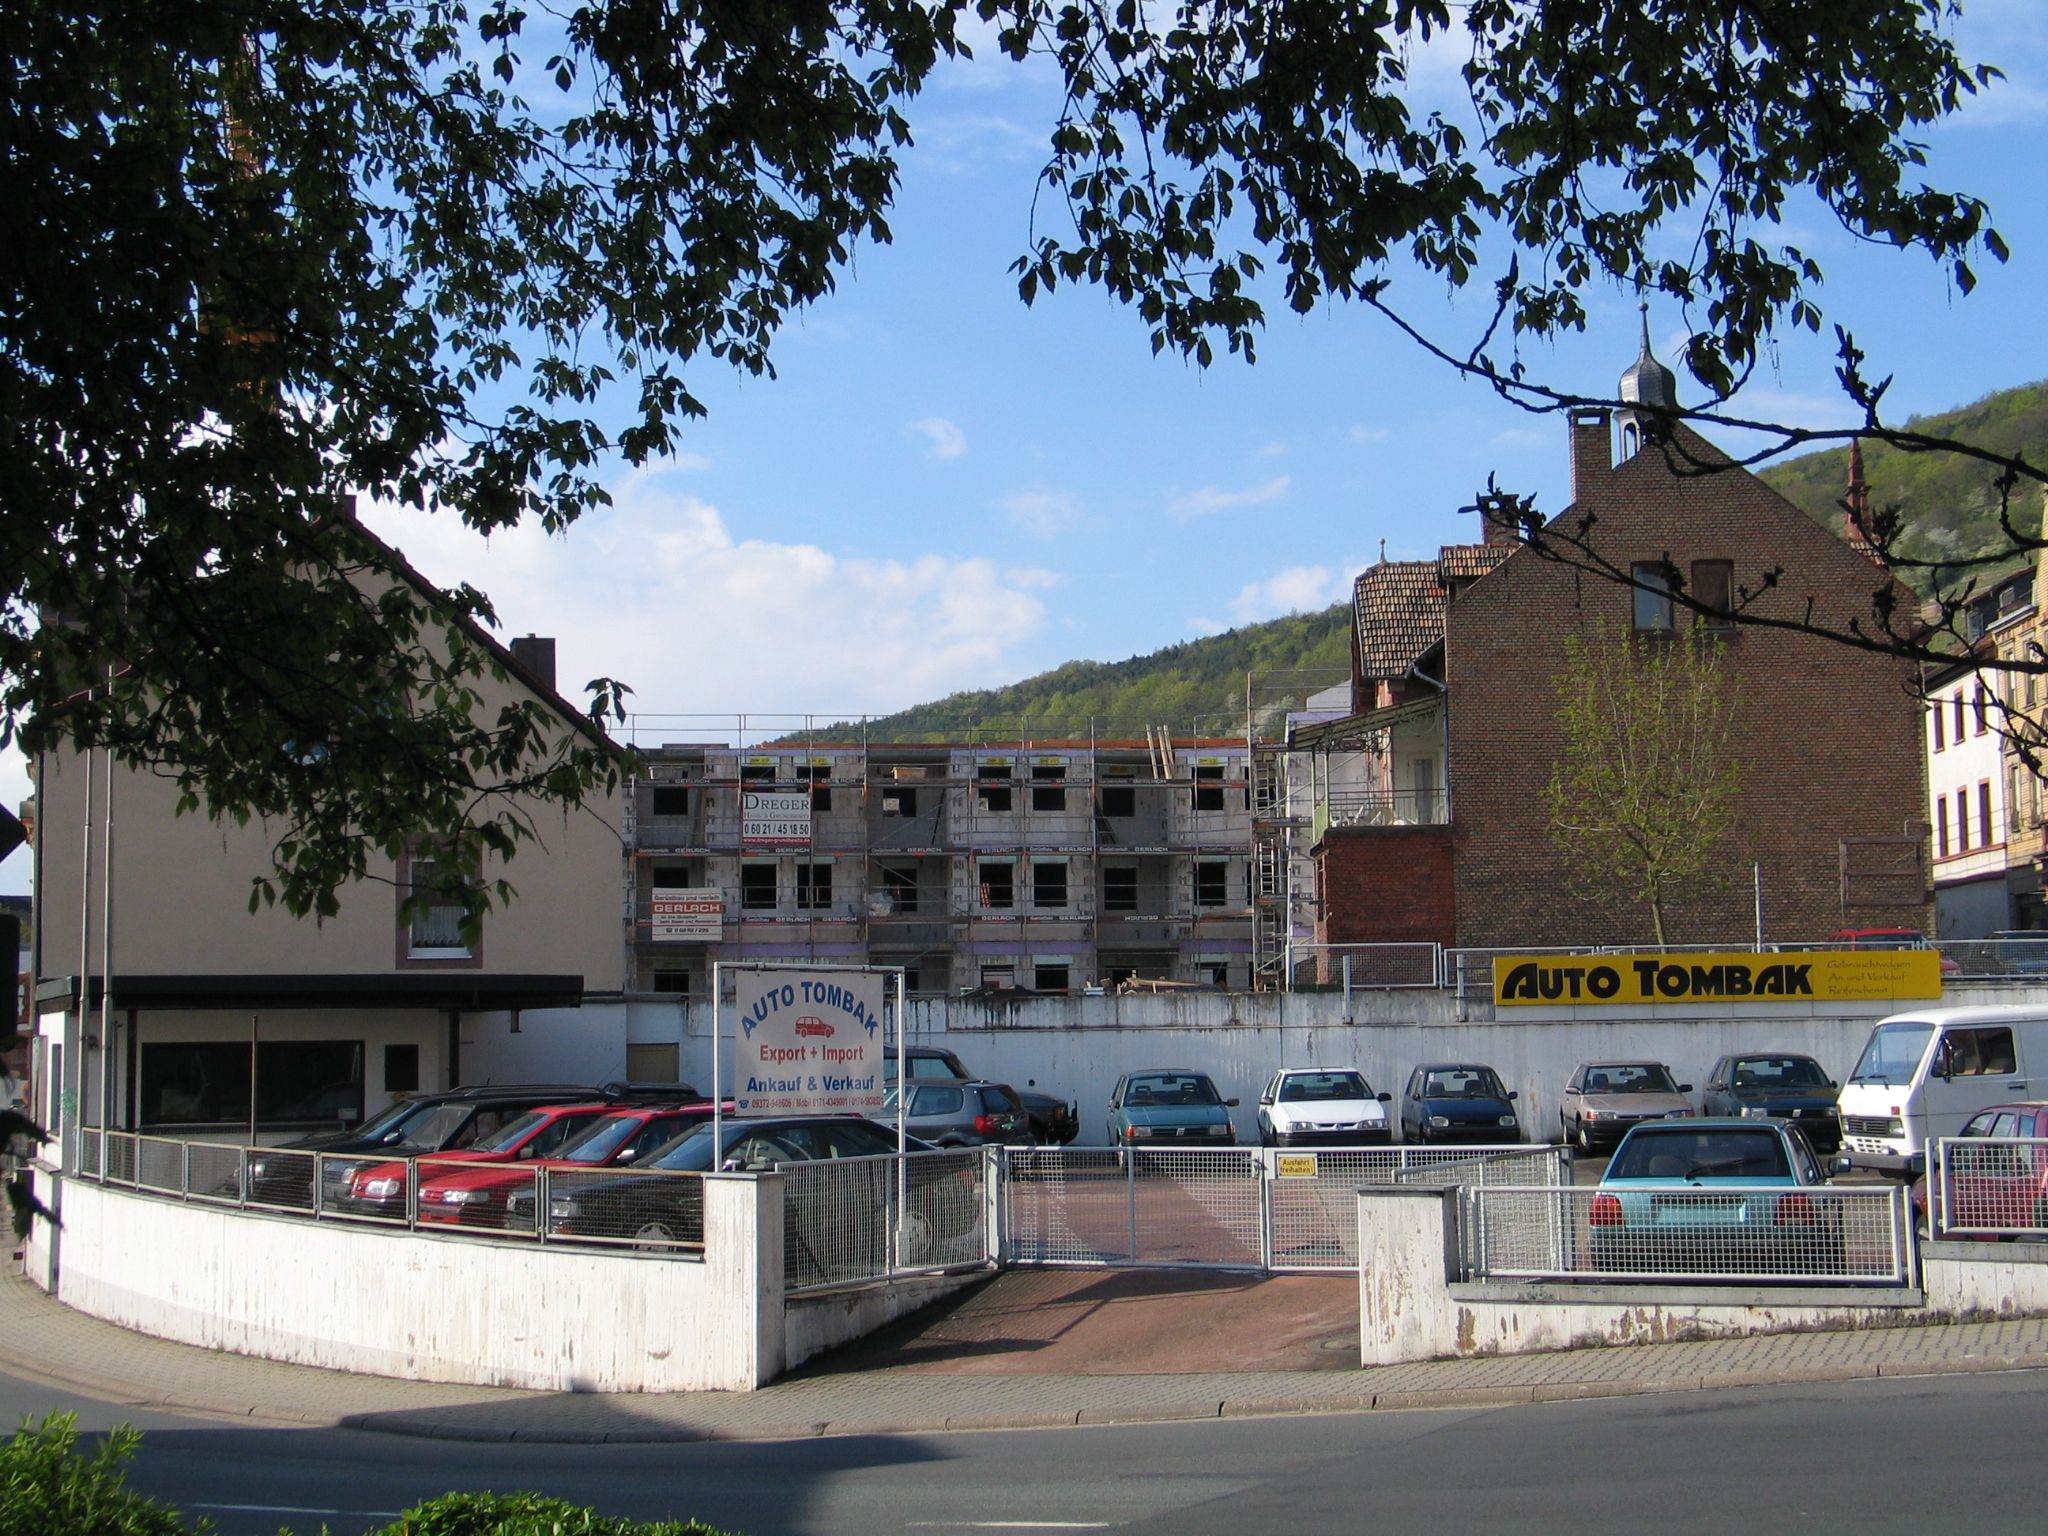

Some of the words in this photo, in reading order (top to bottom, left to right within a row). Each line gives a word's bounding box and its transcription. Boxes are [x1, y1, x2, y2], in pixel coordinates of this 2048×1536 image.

[744, 794, 809, 810] DREGER
[744, 823, 749, 834] 0
[751, 823, 760, 834] 60
[762, 823, 771, 834] 21
[777, 823, 787, 834] 45
[790, 823, 798, 834] 18
[799, 823, 809, 834] 50
[654, 904, 720, 913] GERLACH
[1502, 963, 1621, 1000] AUTO
[1633, 960, 1813, 997] TOMBAK
[741, 984, 795, 1040] AUTO
[801, 981, 879, 1040] TOMBAK
[759, 1044, 806, 1064] Export
[810, 1048, 818, 1059] +
[822, 1044, 864, 1064] Import
[747, 1076, 802, 1092] Ankauf
[807, 1076, 818, 1091] &
[823, 1075, 875, 1091] Verkauf
